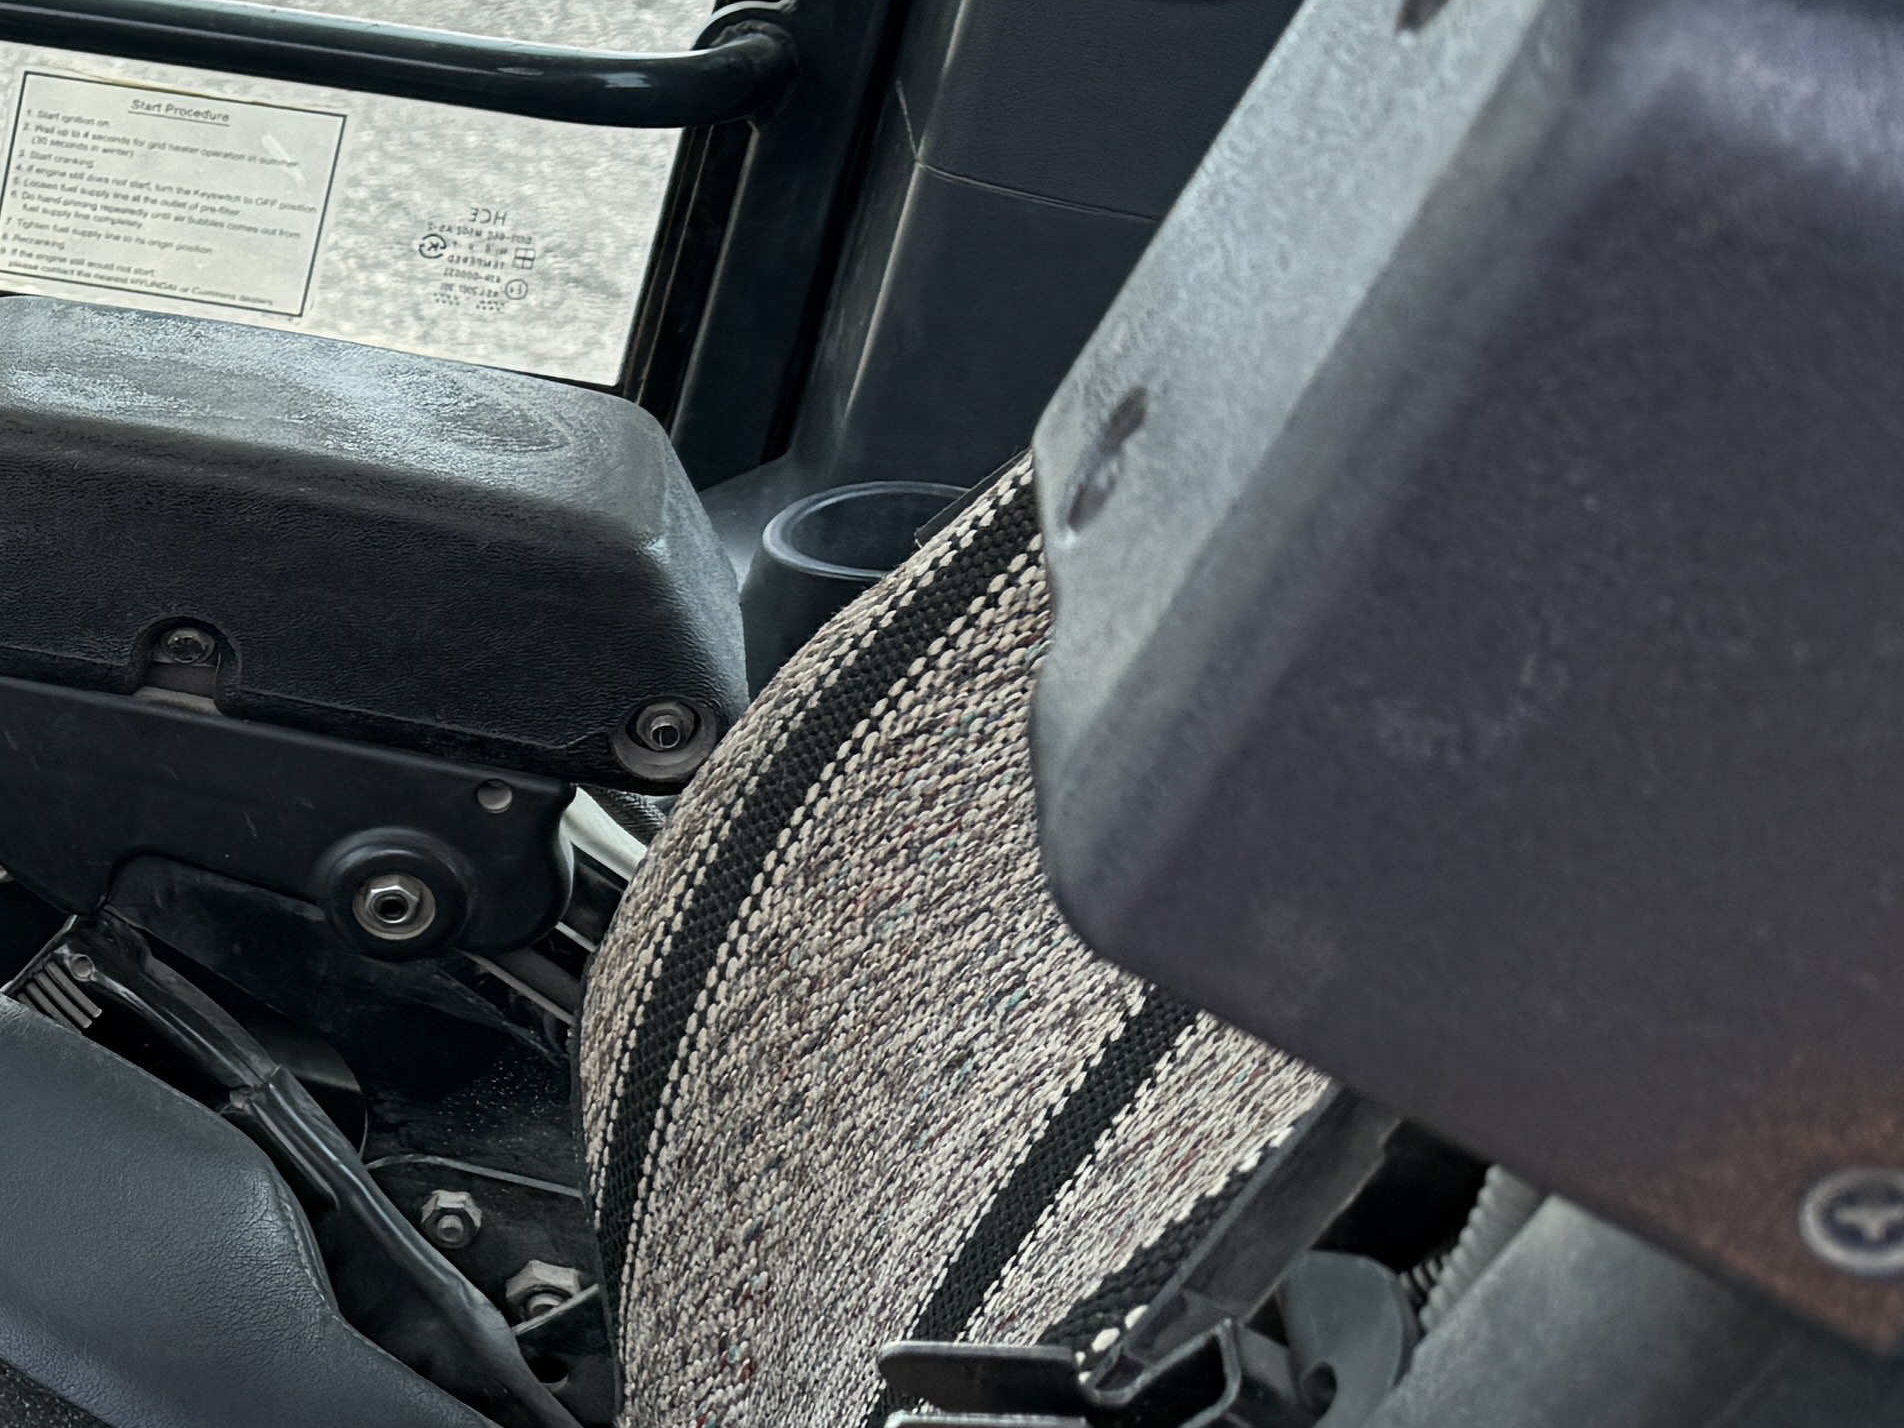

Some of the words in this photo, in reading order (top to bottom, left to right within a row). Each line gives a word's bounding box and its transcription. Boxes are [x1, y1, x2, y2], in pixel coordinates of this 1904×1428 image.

[130, 98, 161, 111] Start
[165, 102, 230, 120] Procedure
[49, 137, 88, 150] seconds
[91, 132, 130, 145] seconds
